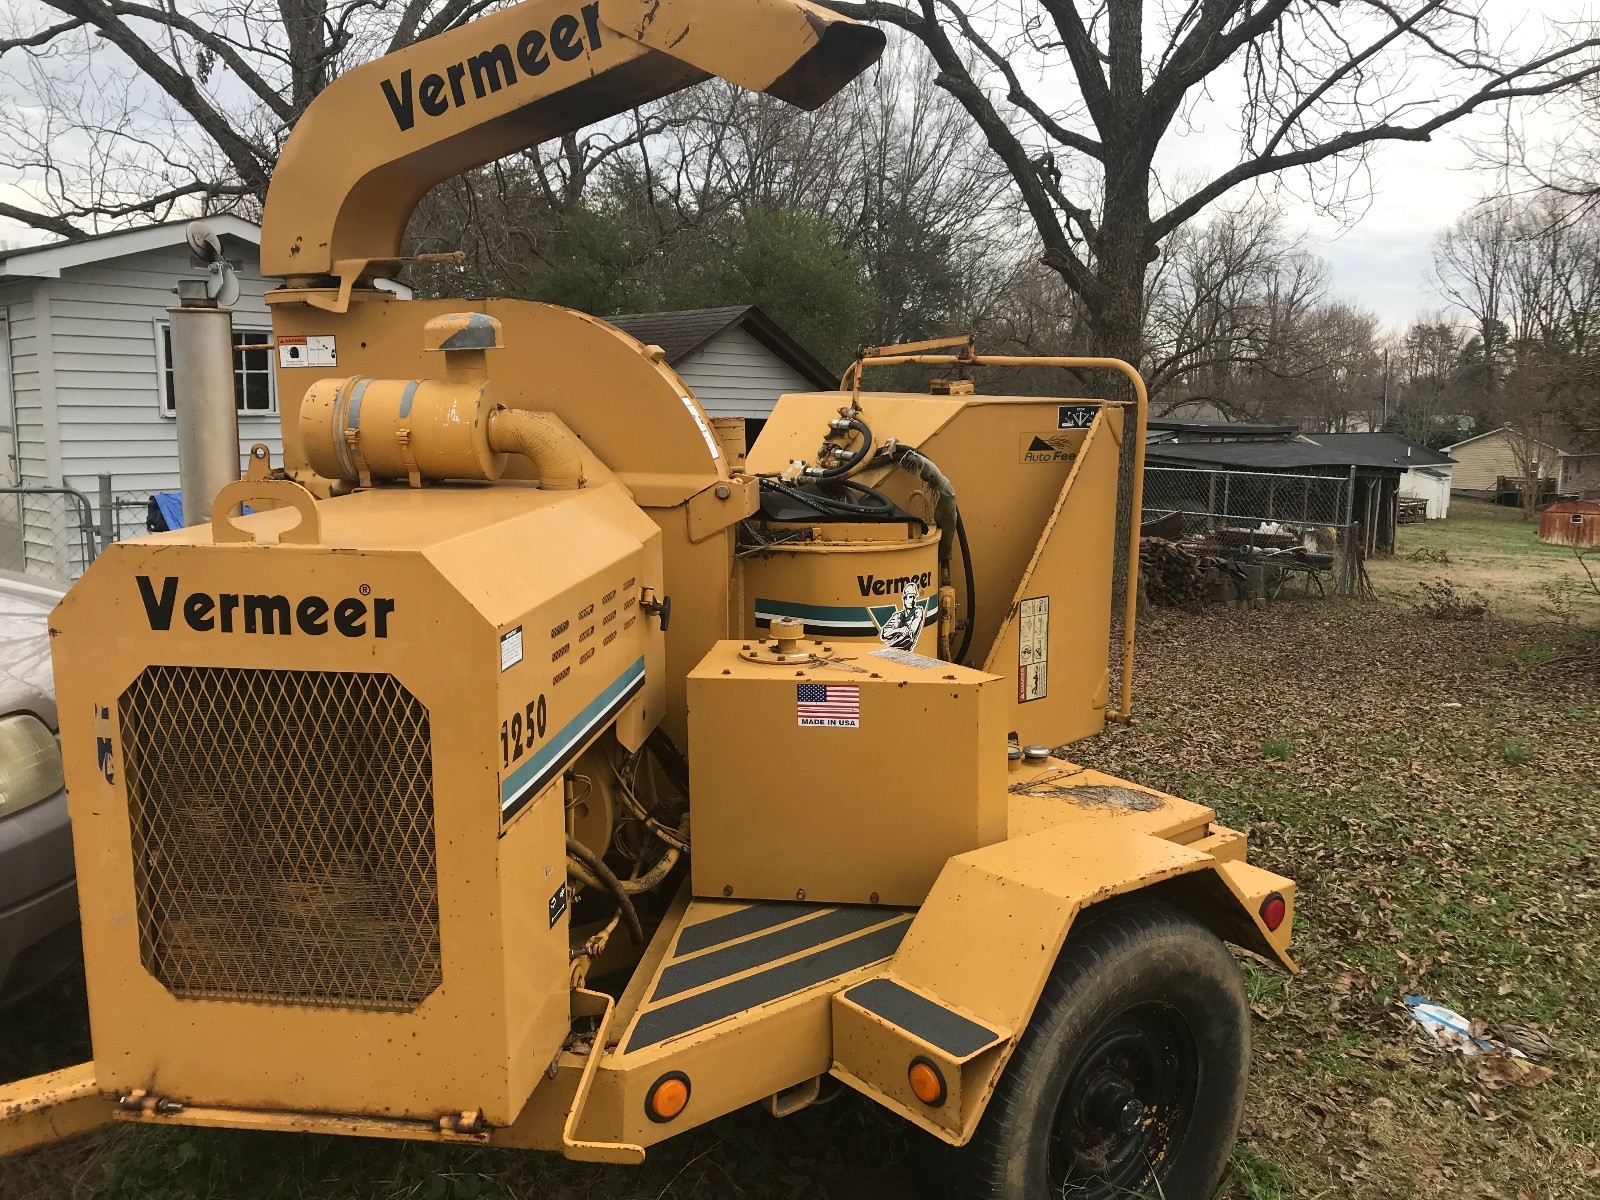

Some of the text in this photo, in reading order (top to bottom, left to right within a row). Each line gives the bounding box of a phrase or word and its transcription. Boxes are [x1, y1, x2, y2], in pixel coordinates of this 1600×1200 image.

[379, 1, 603, 132] Vermeer
[1024, 451, 1077, 462] Auto Fee
[857, 571, 932, 597] Vermeer
[500, 693, 547, 769] 1250
